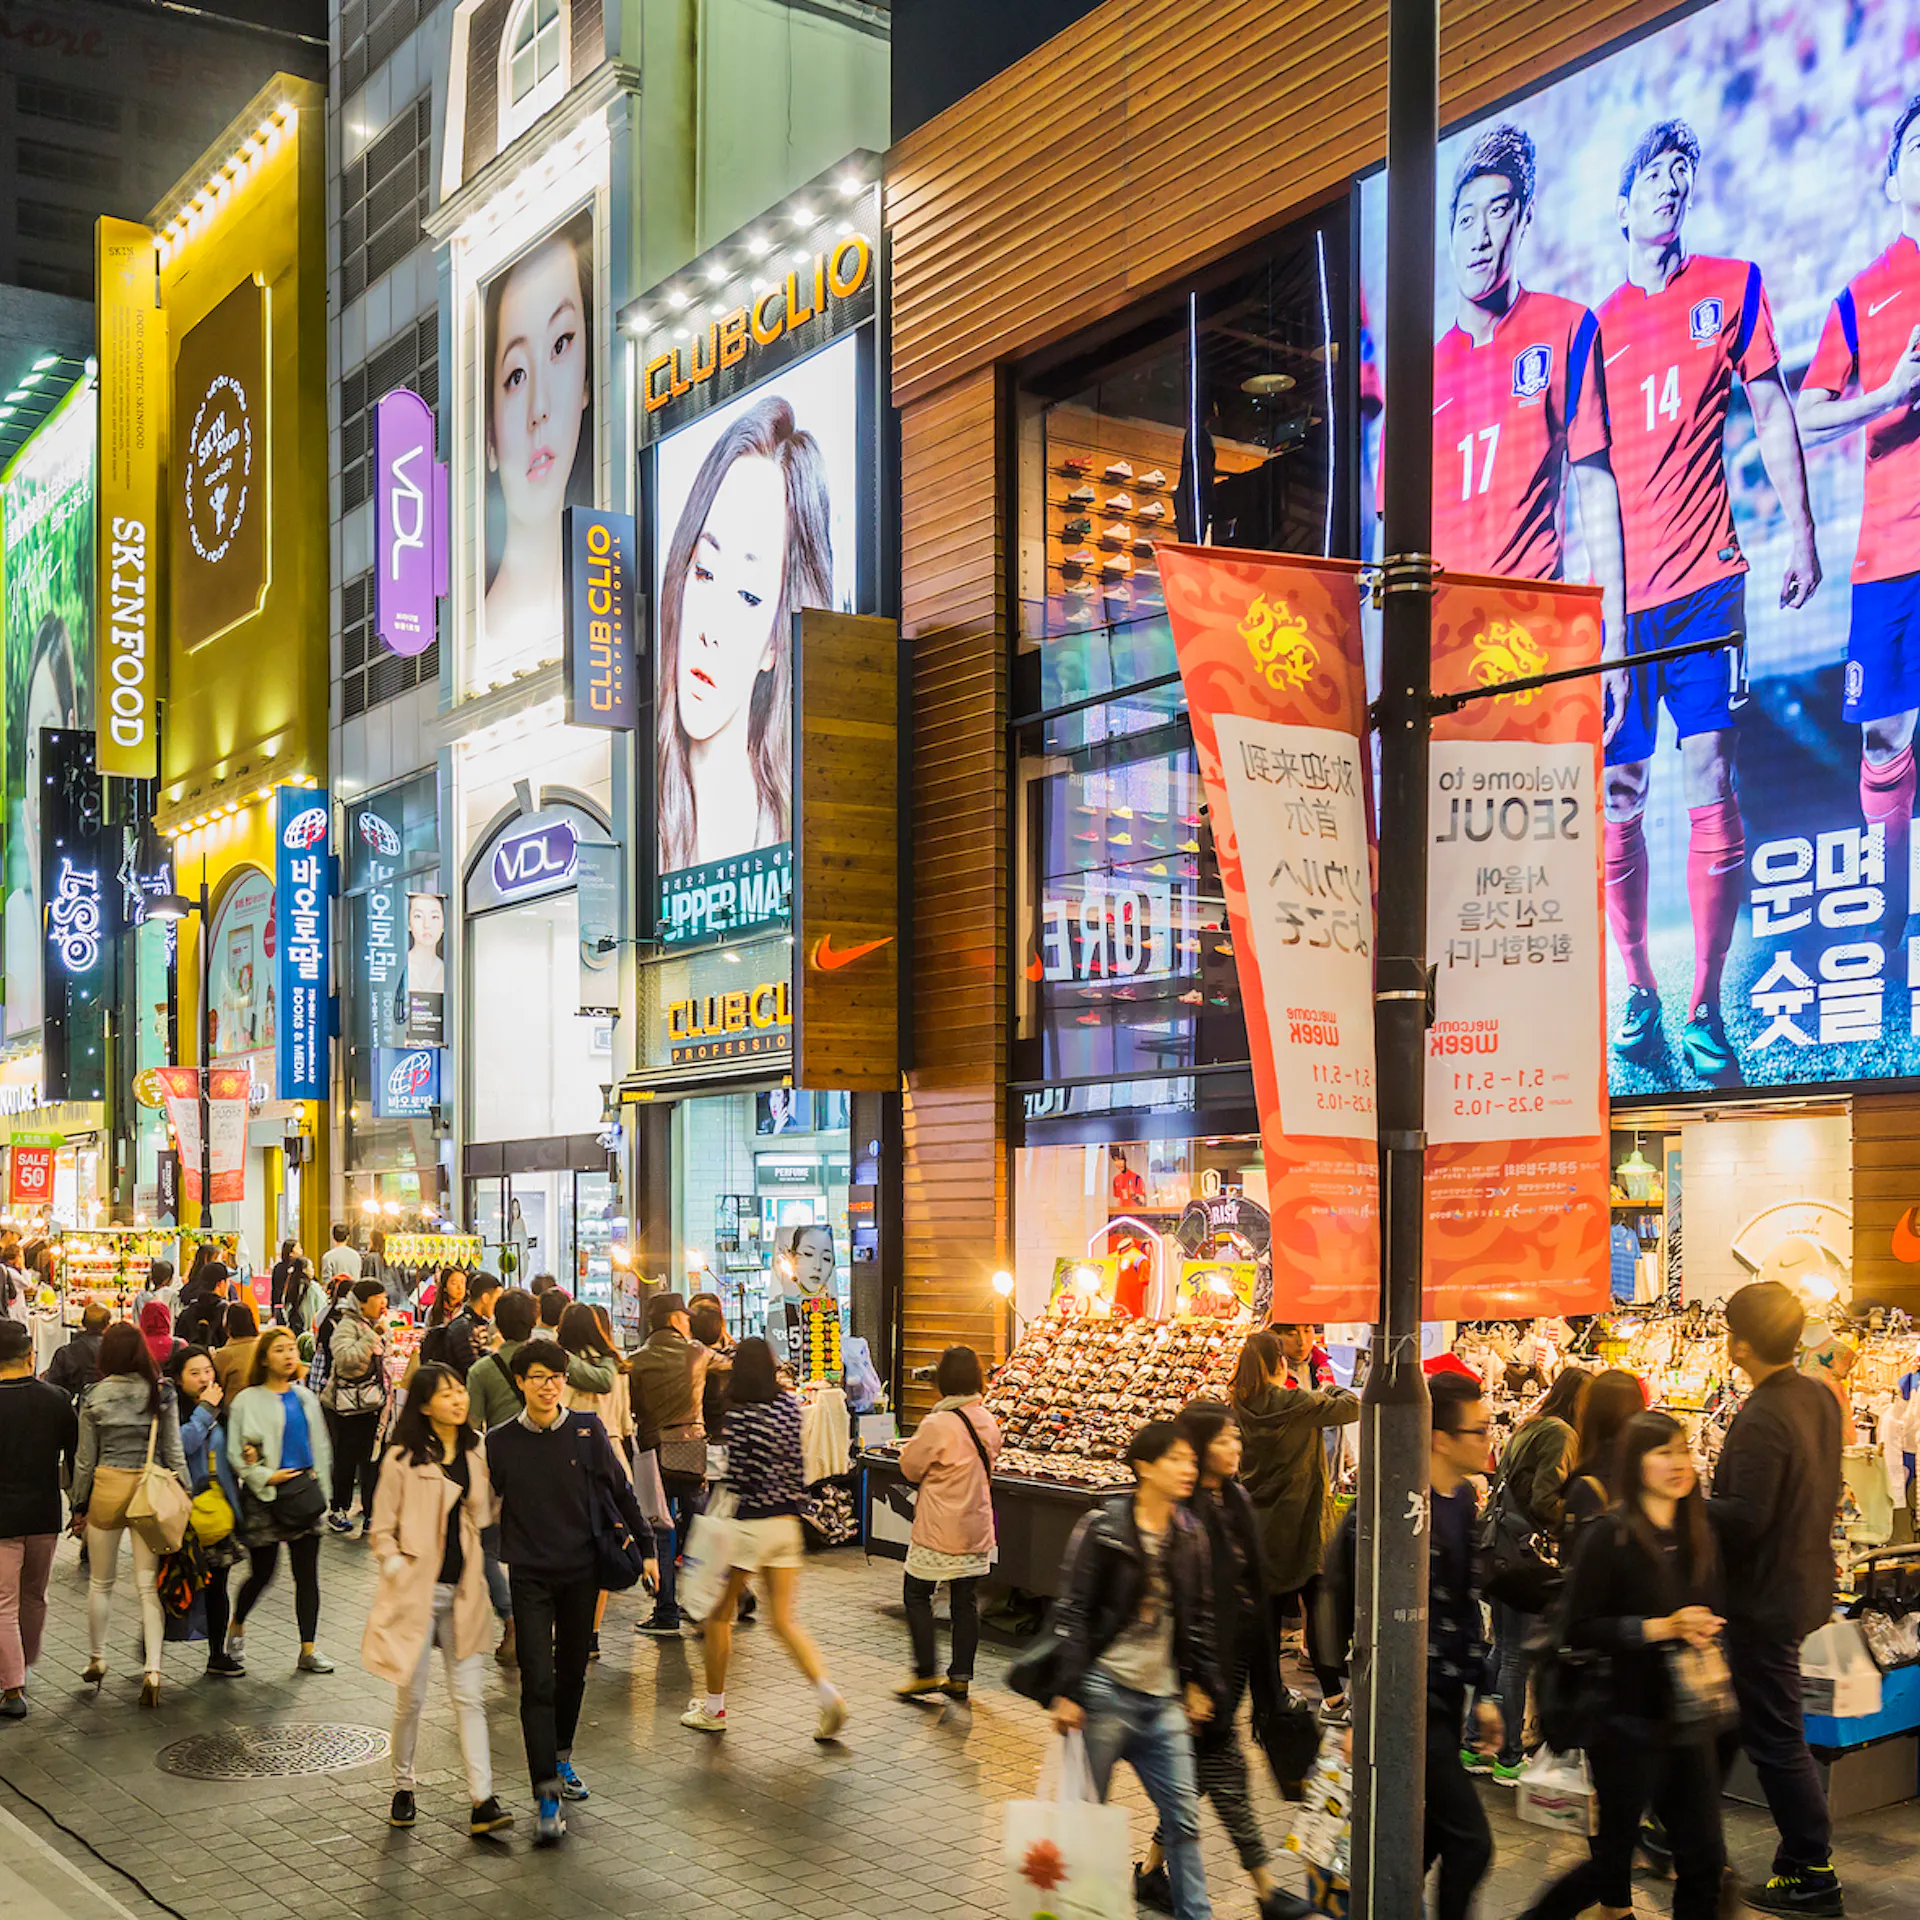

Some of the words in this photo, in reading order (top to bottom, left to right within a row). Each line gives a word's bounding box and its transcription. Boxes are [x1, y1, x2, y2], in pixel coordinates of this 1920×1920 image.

[1640, 364, 1682, 432] 14
[197, 410, 227, 467] SKIN
[1457, 423, 1500, 502] 17
[390, 445, 424, 581] VDL
[110, 516, 146, 747] SKINFOOD
[612, 536, 623, 706] PROFESSIONAL
[499, 836, 565, 882] VDL
[1750, 822, 1887, 938] 운명
[287, 855, 323, 980] 바오로딸
[661, 881, 738, 942] UPPER
[293, 987, 305, 1029] BOOKS
[1746, 941, 1886, 1050] 슛을
[293, 1031, 305, 1042] &
[293, 1044, 305, 1084] MEDIA
[672, 1034, 787, 1062] PROFESSIO
[388, 1095, 434, 1109] 바오로딸
[17, 1153, 49, 1167] SALE
[774, 1167, 810, 1177] PERFUME
[1211, 1204, 1240, 1226] RISK
